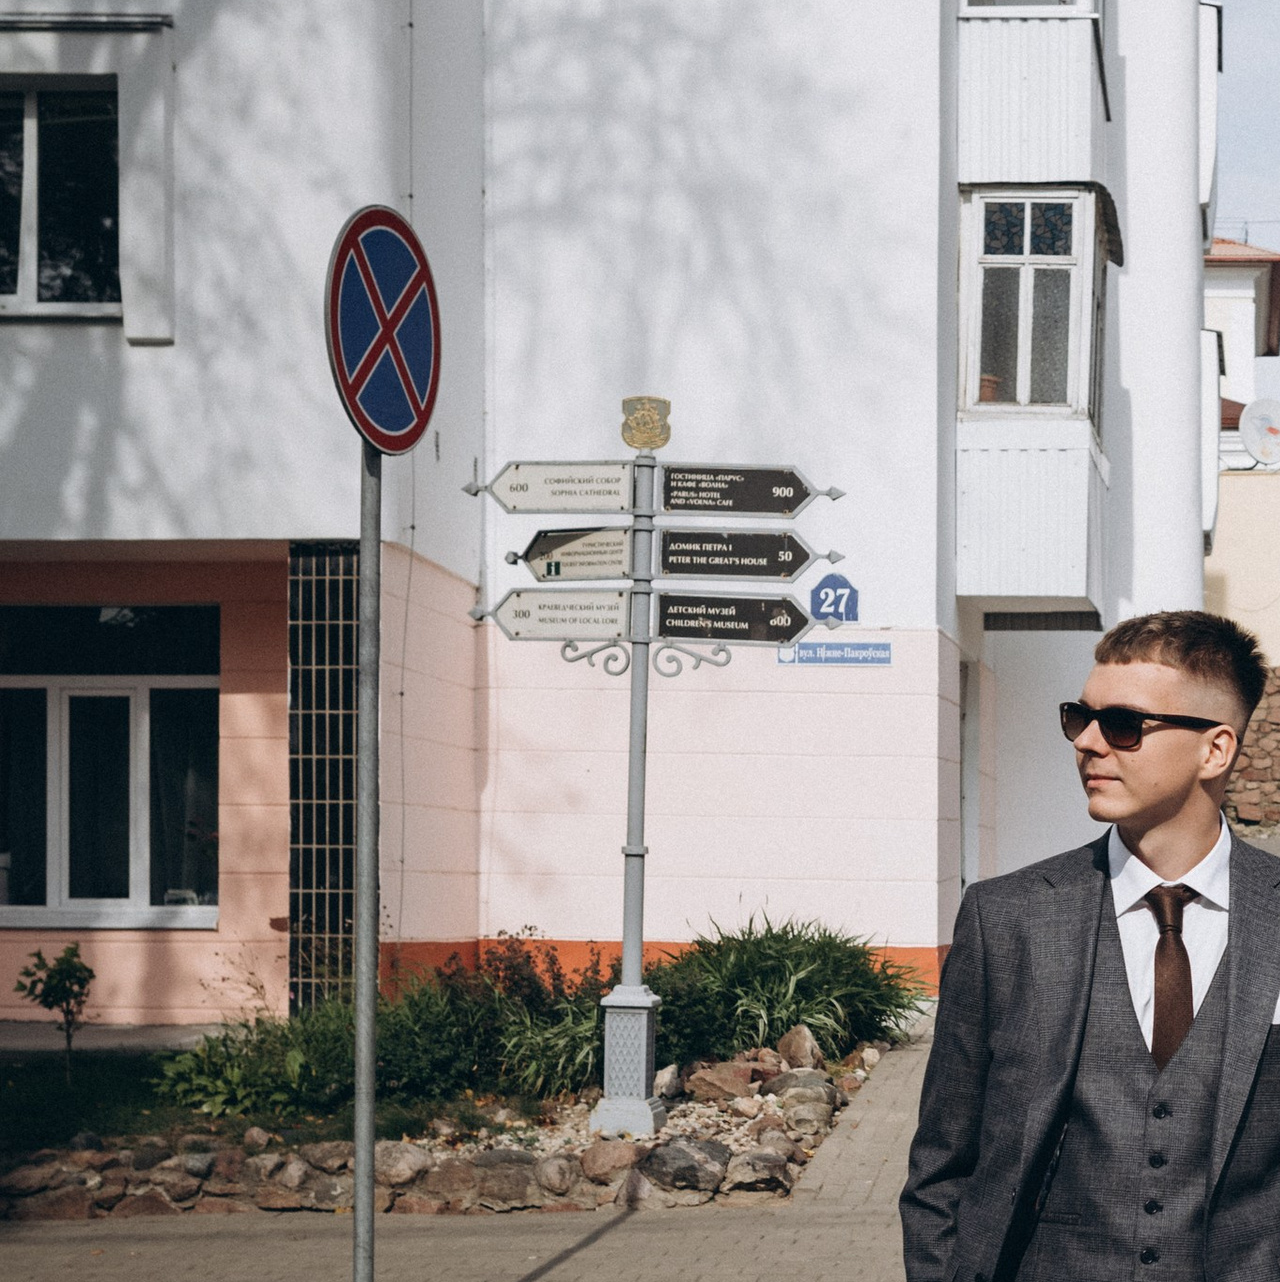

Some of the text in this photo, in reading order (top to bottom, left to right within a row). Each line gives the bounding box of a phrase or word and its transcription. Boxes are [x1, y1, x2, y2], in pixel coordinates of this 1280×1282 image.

[543, 475, 622, 485] СОФИЙСКИЙ СОБОР
[670, 473, 714, 481] ГОСТИНИЦА
[509, 483, 529, 493] 600
[772, 486, 794, 498] 900
[699, 491, 721, 499] HOTEL
[668, 542, 701, 551] ДОМИК
[702, 543, 728, 551] ПЕТРА
[668, 556, 768, 566] PETER THE GREAT'S HOUSE
[777, 551, 793, 562] 50
[819, 587, 851, 614] 27
[538, 602, 620, 612] КРАЕВЕДЧЕСКИЙ МУЗЕЙ
[667, 604, 736, 616] ДЕТСКИЙ МУЗЕЙ
[512, 609, 531, 619] 300
[579, 617, 600, 625] LOCAL
[665, 618, 749, 630] CHILDREN'S MUSEUM
[799, 649, 815, 660] вул.
